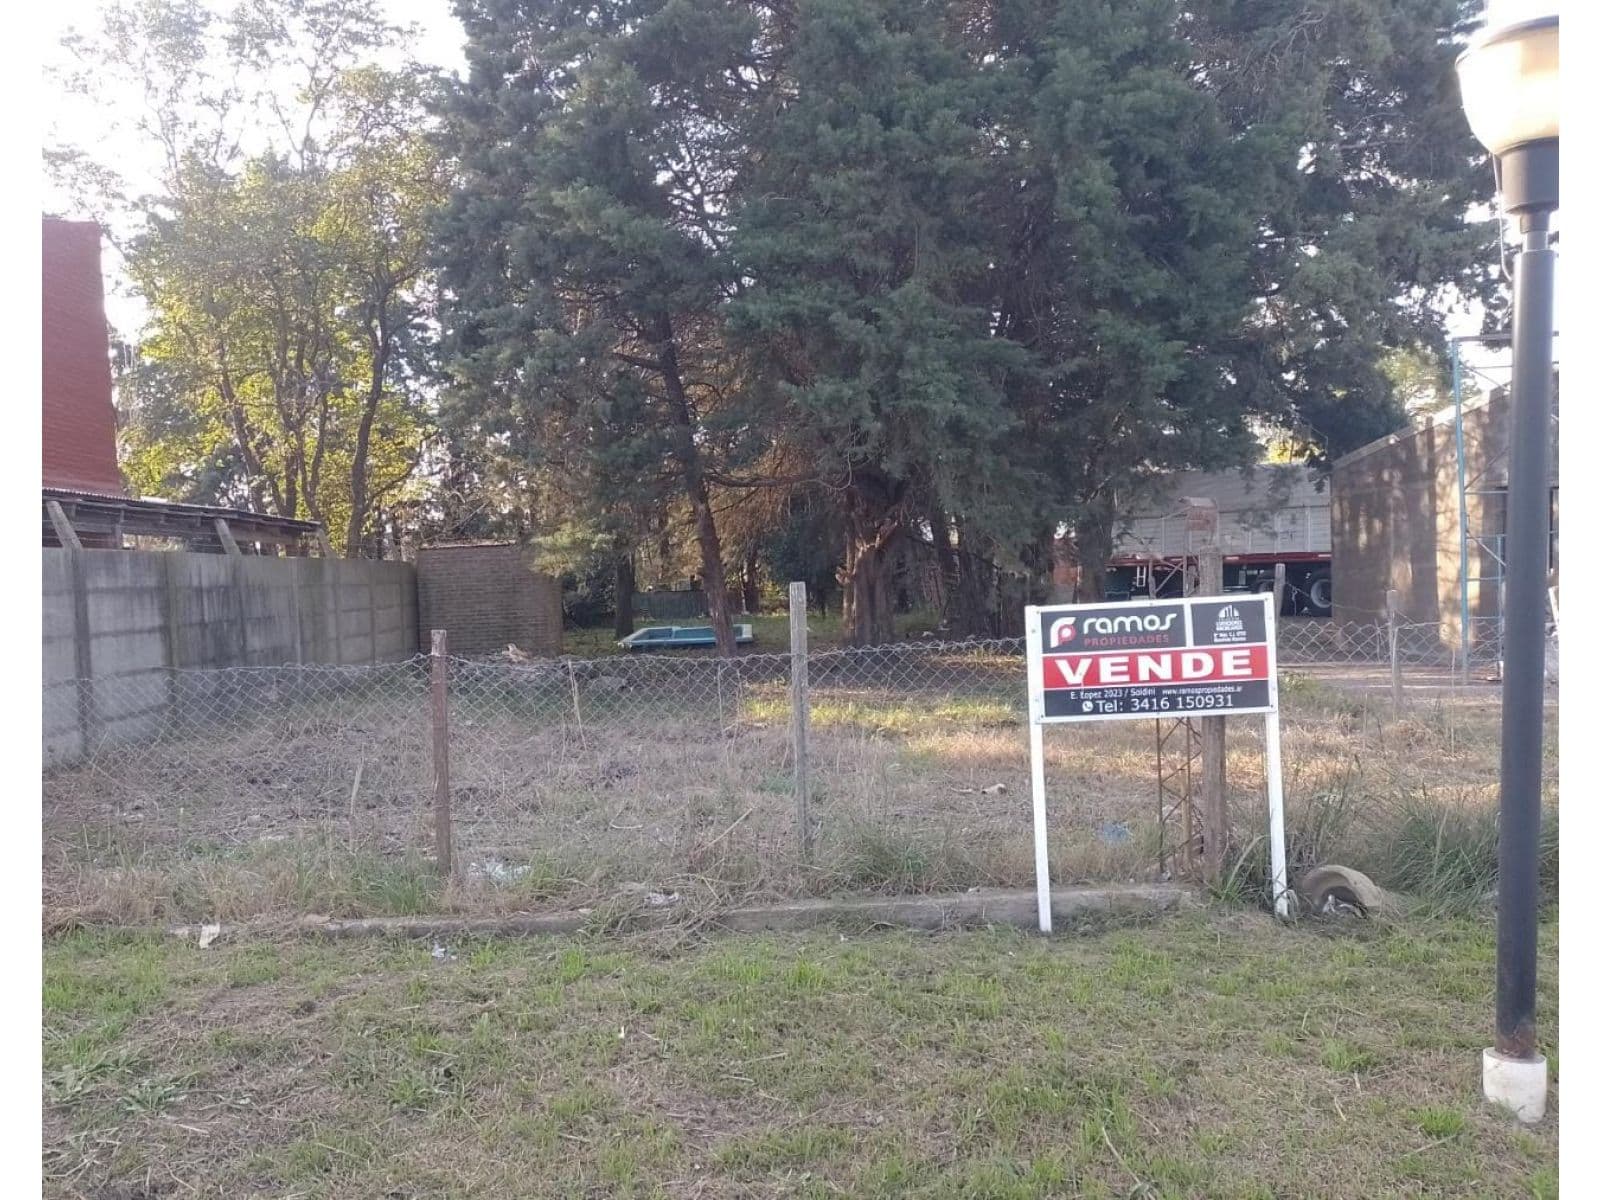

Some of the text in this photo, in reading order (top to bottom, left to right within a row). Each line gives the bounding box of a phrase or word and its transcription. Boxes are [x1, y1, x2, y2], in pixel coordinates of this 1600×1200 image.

[1082, 613, 1177, 634] ramos
[1084, 634, 1169, 646] PROPIEDADES
[1055, 649, 1253, 685] VENDE
[1103, 689, 1124, 698] 2023
[1095, 694, 1234, 713] Tel: 3416 150931
